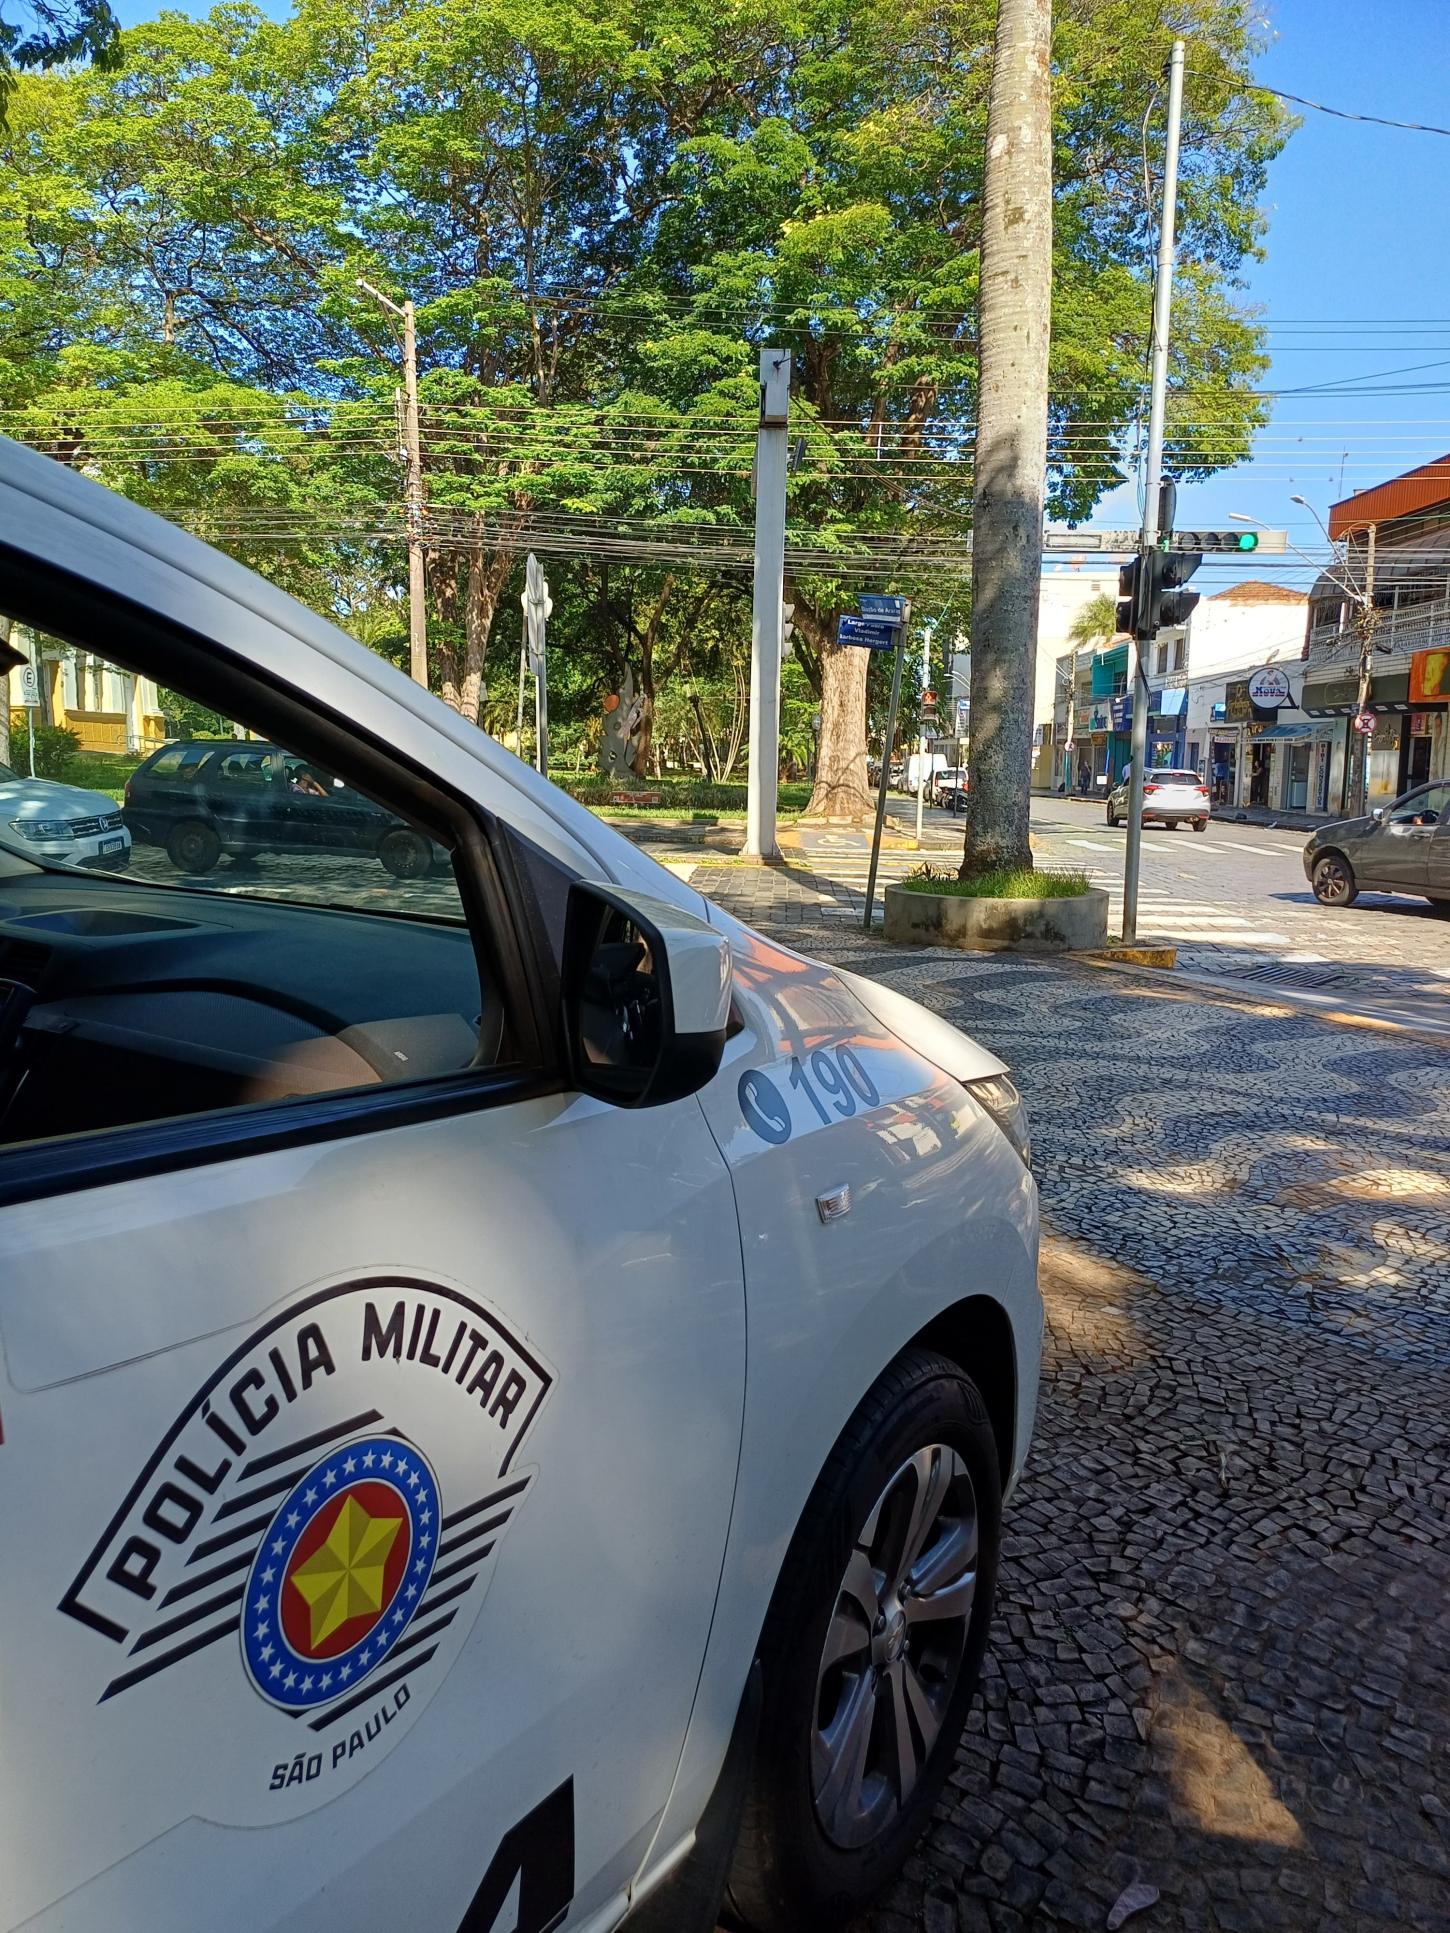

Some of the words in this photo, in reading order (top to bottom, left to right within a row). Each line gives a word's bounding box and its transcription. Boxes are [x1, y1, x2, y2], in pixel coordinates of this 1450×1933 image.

[26, 672, 32, 684] E
[789, 1044, 881, 1125] 190
[106, 1321, 336, 1600] POLÍCIA
[361, 1301, 527, 1430] MILITAR
[269, 1752, 322, 1791] SÃO
[332, 1683, 411, 1769] PAULO
